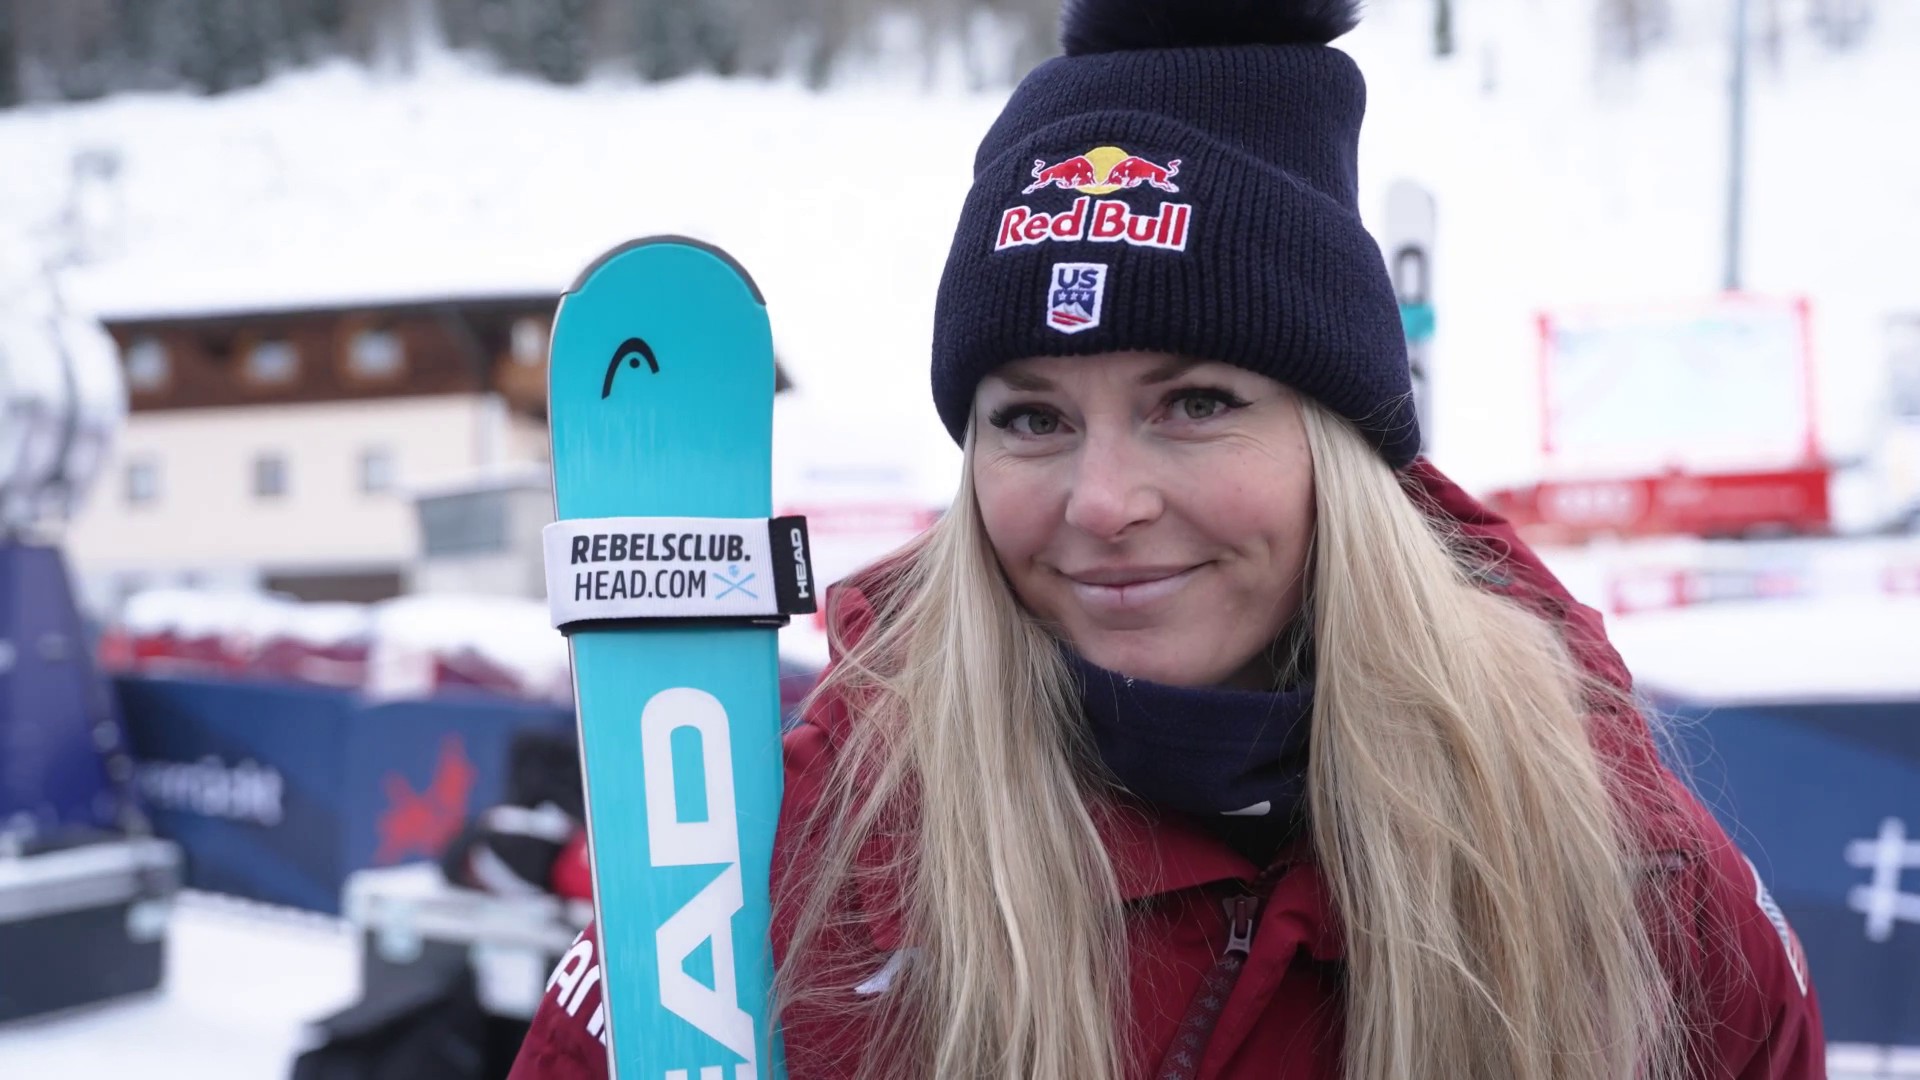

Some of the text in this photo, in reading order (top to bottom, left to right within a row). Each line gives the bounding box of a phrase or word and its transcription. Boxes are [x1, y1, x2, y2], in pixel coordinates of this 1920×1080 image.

[996, 197, 1191, 250] Red Bull
[1057, 267, 1099, 290] US
[570, 533, 752, 565] REBELSCLUB.
[790, 527, 810, 599] HEAD
[574, 569, 707, 602] HEAD.COM
[640, 686, 758, 1080] AD
